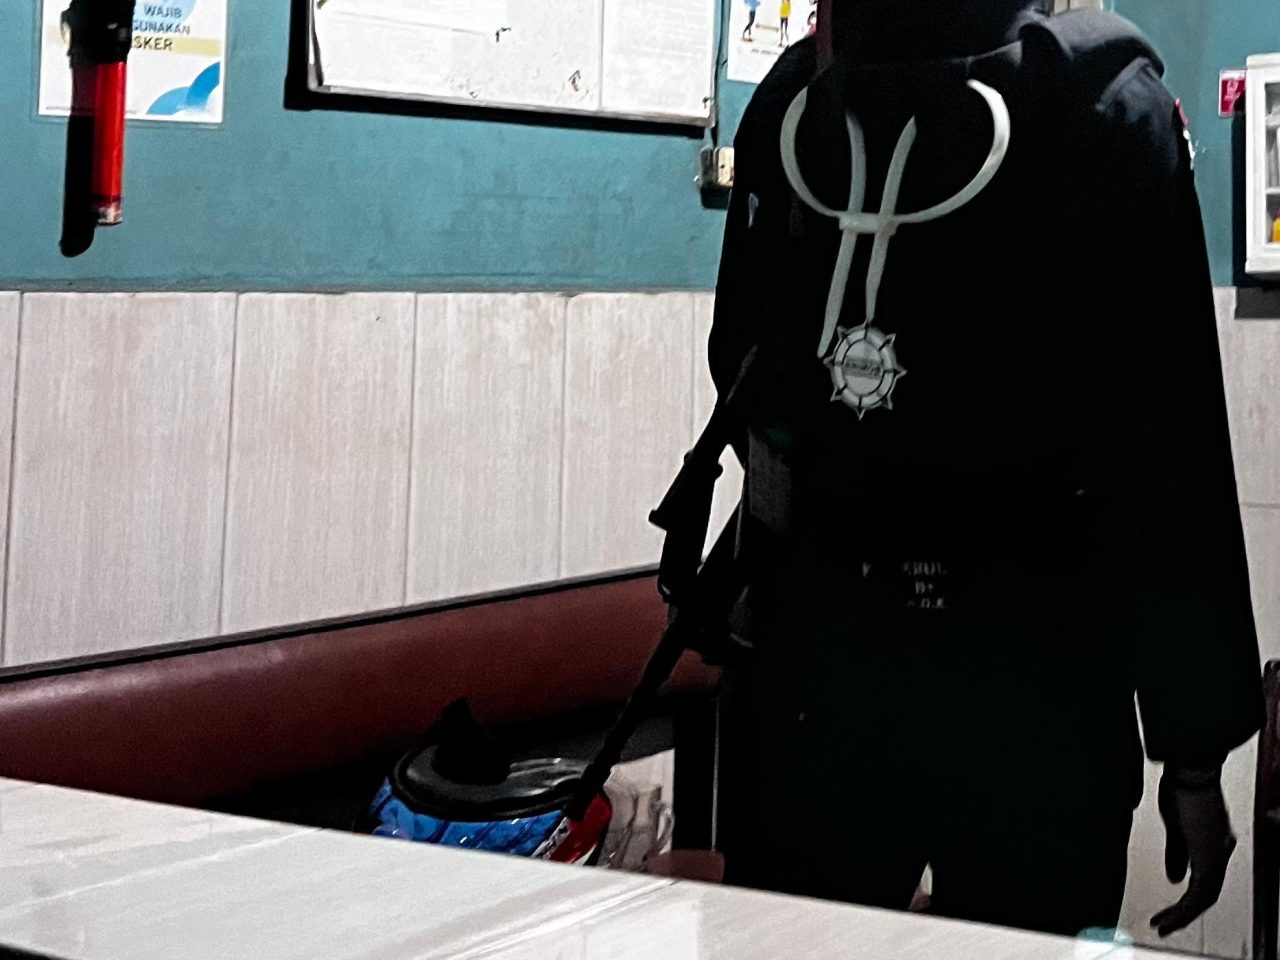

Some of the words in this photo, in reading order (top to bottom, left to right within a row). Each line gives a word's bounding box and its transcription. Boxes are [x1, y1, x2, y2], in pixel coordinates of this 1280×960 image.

[143, 4, 182, 19] WAJIB
[133, 20, 190, 35] GUNAKAN
[133, 35, 173, 51] SKER
